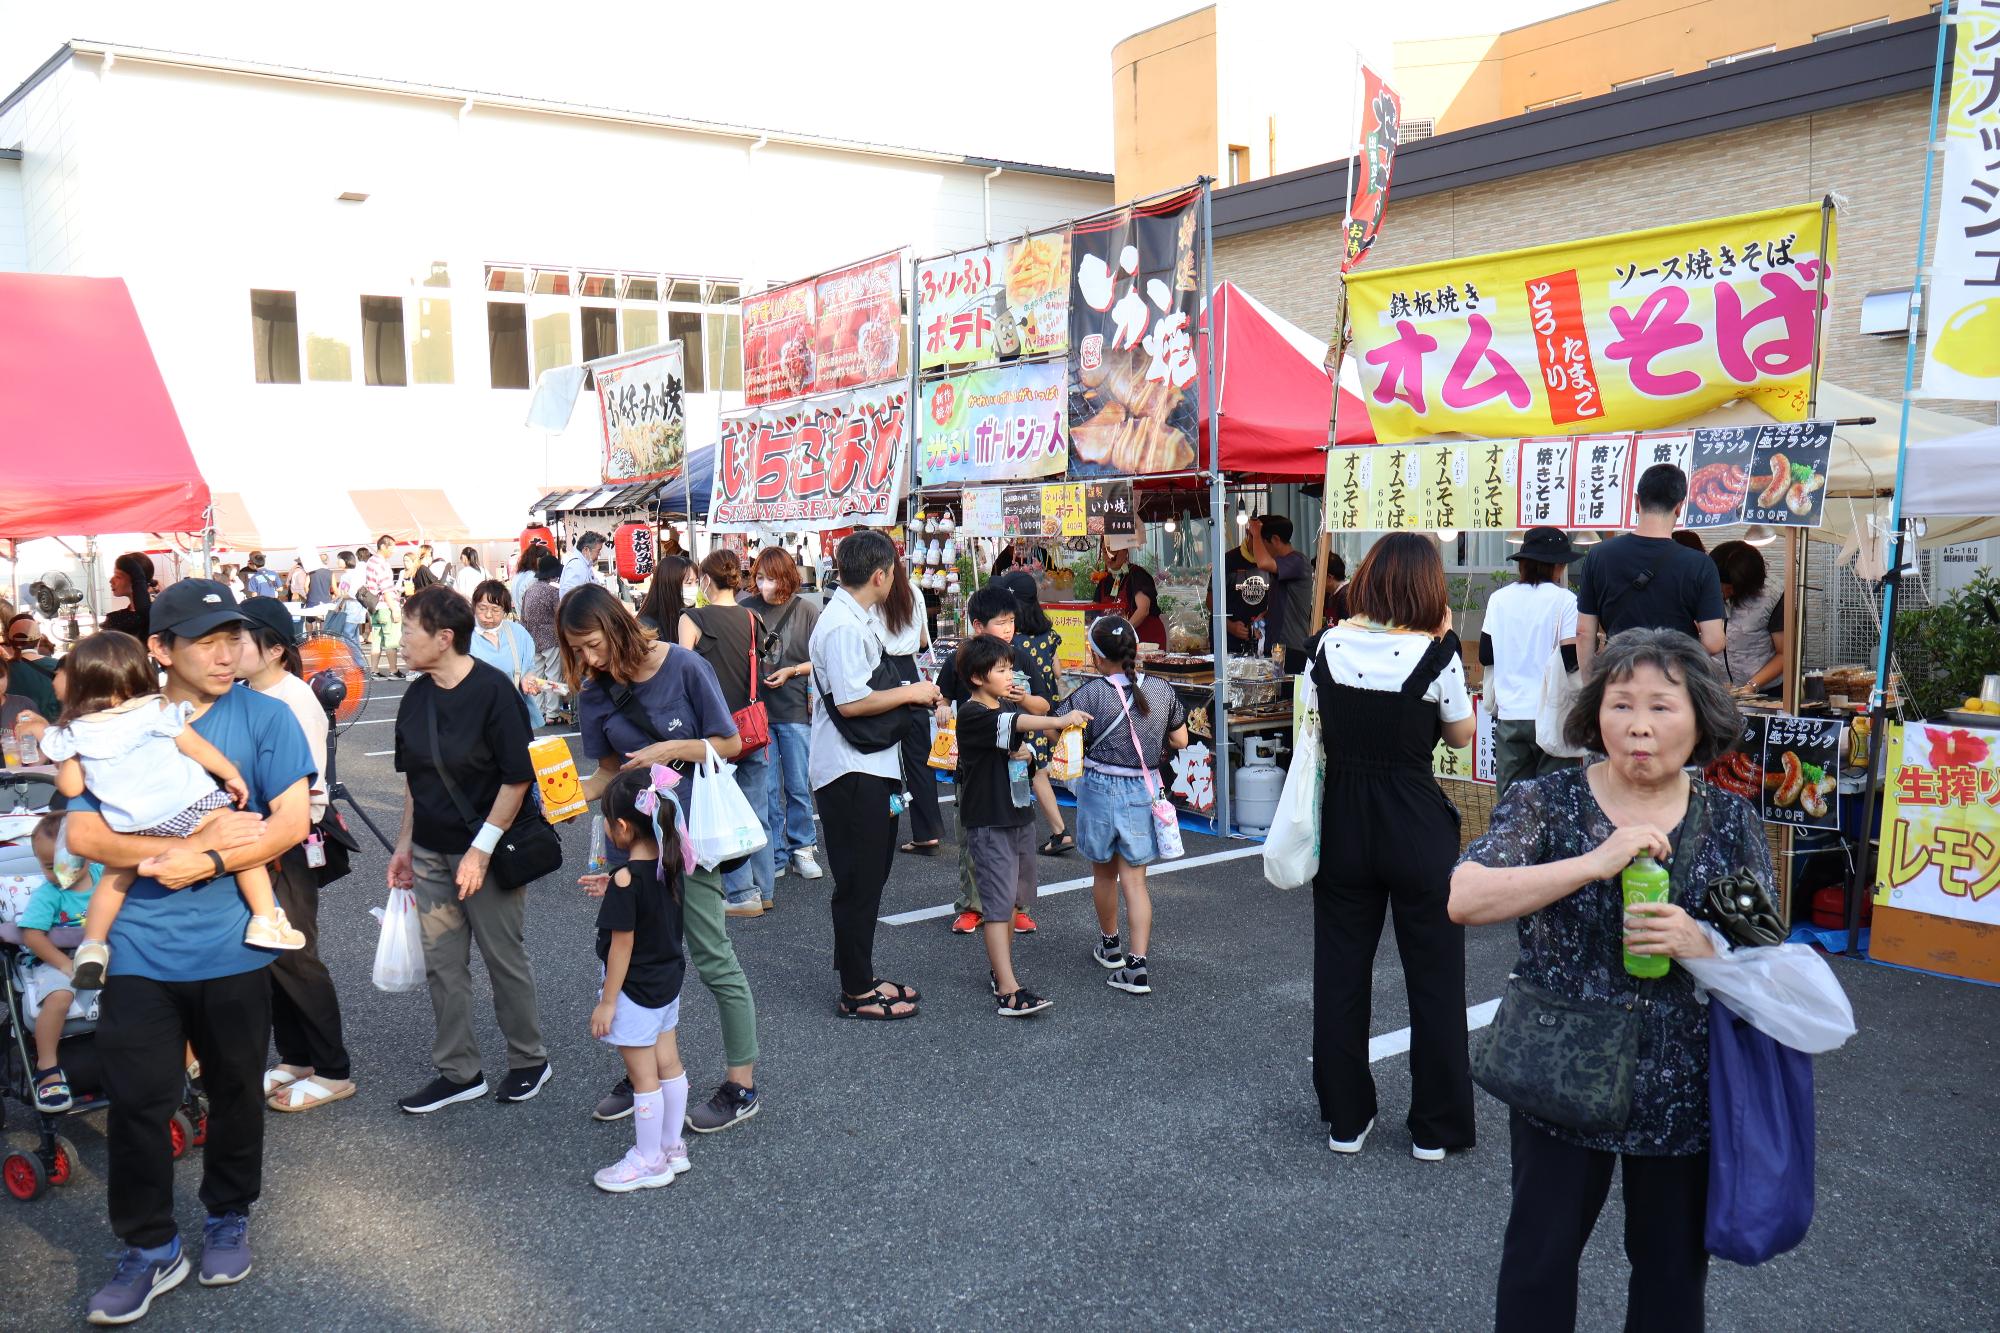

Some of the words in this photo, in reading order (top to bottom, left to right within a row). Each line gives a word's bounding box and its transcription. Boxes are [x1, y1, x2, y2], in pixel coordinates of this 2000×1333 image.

[1616, 234, 1798, 290] ソース焼きそば
[1078, 245, 1199, 390] いか焼
[1389, 283, 1480, 318] 鉄板焼き
[927, 307, 991, 354] ポテト
[1365, 313, 1532, 415] オム
[1605, 259, 1832, 397] そば
[1562, 337, 1600, 417] たまご
[721, 405, 904, 502] いちごあめ
[1703, 440, 1750, 455] フランク
[1758, 435, 1828, 449] 生フランク
[1436, 447, 1453, 528] オムそば
[1484, 444, 1503, 528] オムそば
[1536, 447, 1554, 520] 焼きそば
[1554, 447, 1568, 490] ソース
[1590, 445, 1609, 519] 焼きそば
[1608, 445, 1624, 488] ソース
[1056, 503, 1083, 518] ポテト
[1091, 498, 1127, 513] いか焼
[1331, 490, 1339, 529] 600円
[1342, 452, 1360, 529] オムそば
[1387, 450, 1406, 528] オムそば
[1425, 487, 1433, 529] 600円
[1473, 486, 1481, 529] 600円
[1524, 481, 1533, 524] 500円
[1578, 480, 1586, 524] 500円
[1688, 513, 1722, 524] 500円
[1768, 730, 1836, 749] 生フランク
[1772, 719, 1824, 734] こだわり
[1480, 737, 1488, 778] 500円
[1765, 807, 1805, 822] 500円
[1888, 818, 2000, 901] レモン
